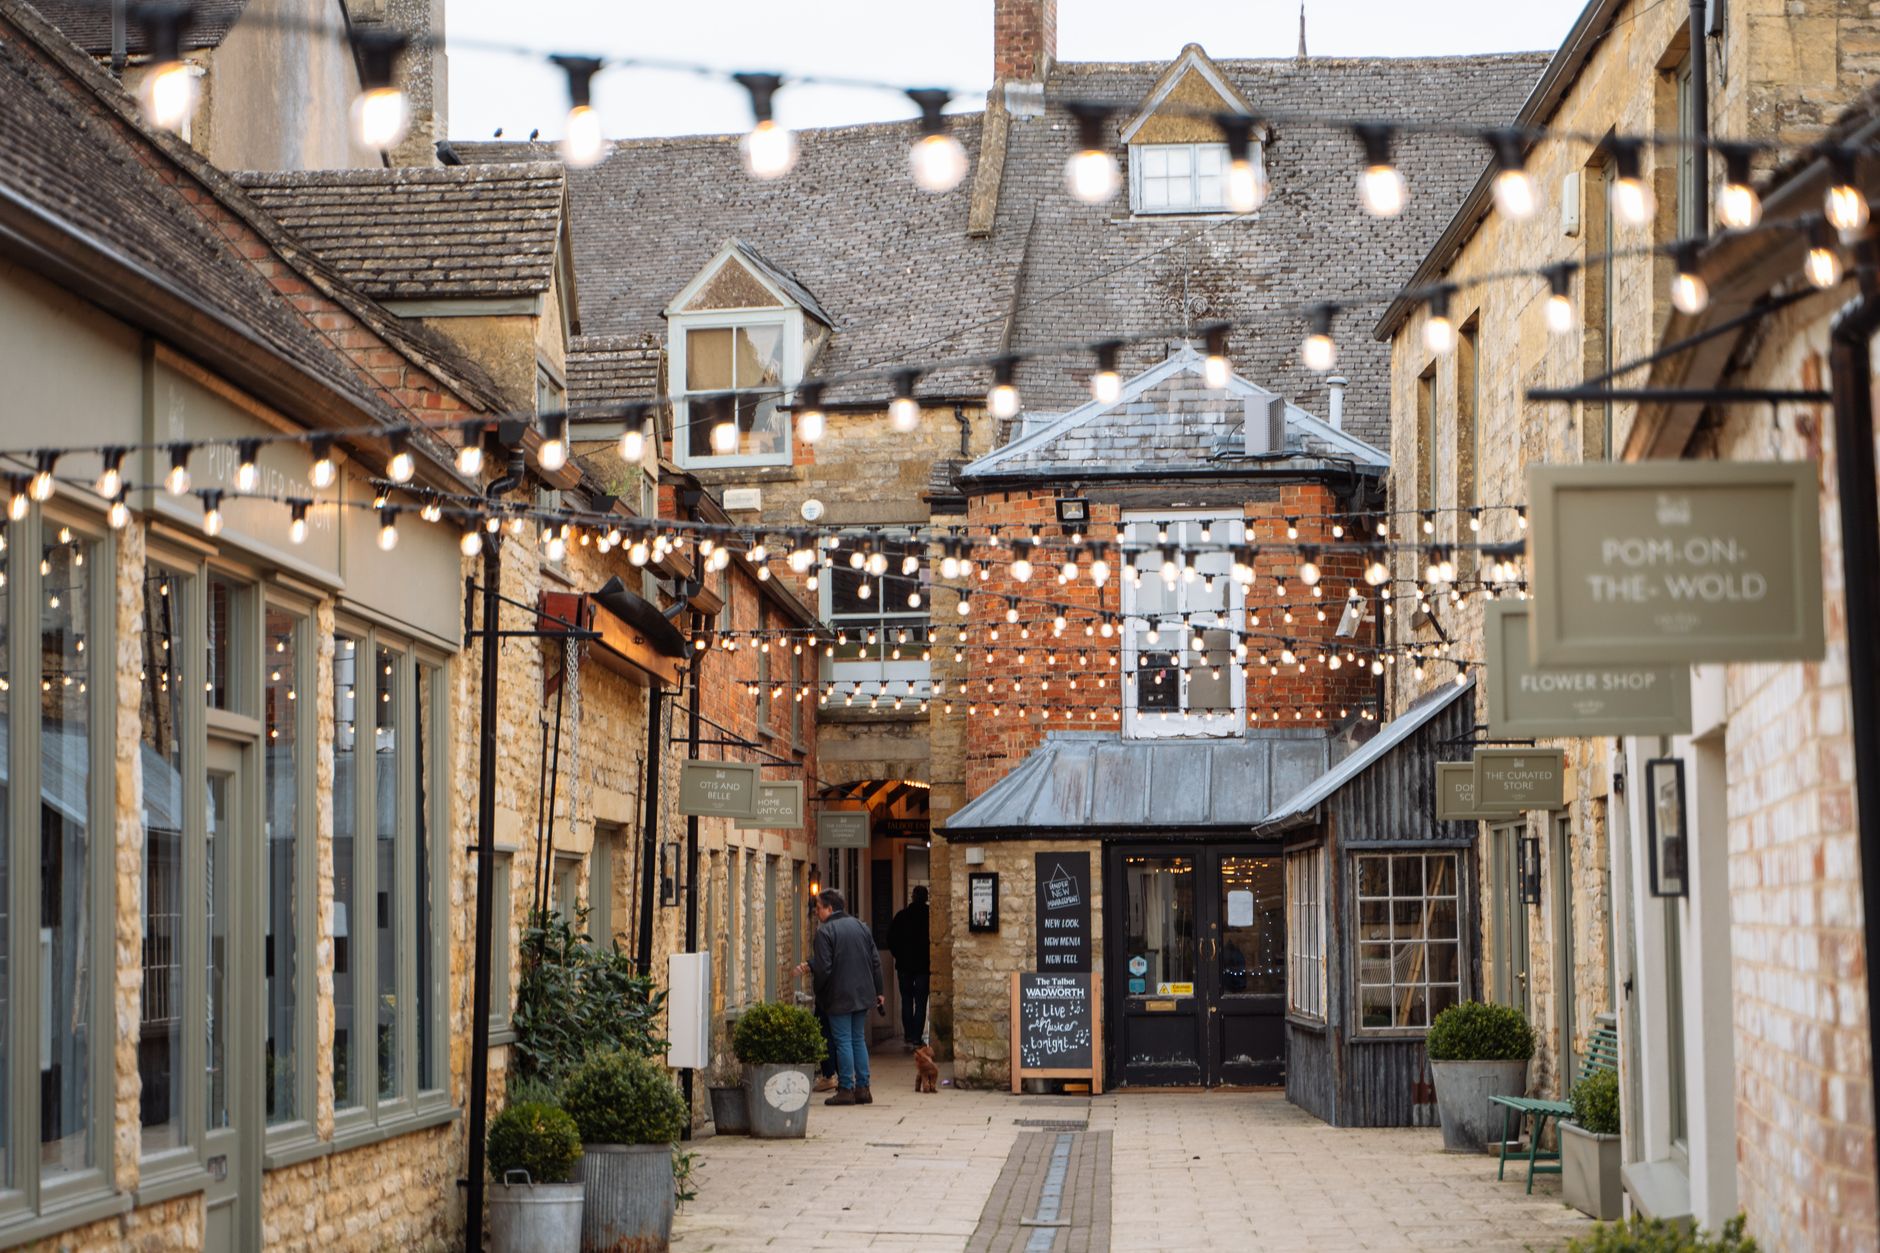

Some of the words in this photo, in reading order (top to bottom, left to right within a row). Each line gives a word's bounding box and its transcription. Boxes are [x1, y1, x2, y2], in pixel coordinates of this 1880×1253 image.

[1520, 673, 1597, 692] FLOWER
[1602, 672, 1656, 690] SHOP
[1486, 771, 1504, 780] THE
[1506, 771, 1552, 780] CURATED
[699, 781, 718, 790] OTIS
[720, 781, 740, 791] AND
[1503, 781, 1534, 790] STORE
[707, 791, 731, 800] BELLE
[1049, 880, 1069, 890] UNDER
[1051, 887, 1070, 898] NEW
[1044, 918, 1060, 928] NEW
[1061, 918, 1080, 928] LOOK
[1044, 937, 1059, 947] NEW
[1060, 937, 1080, 947] MENU
[1045, 954, 1061, 964] NEW
[1063, 954, 1079, 964] FEEL
[1036, 977, 1050, 986] The
[1051, 977, 1076, 986] Talbot
[1025, 987, 1085, 997] WADWORTH
